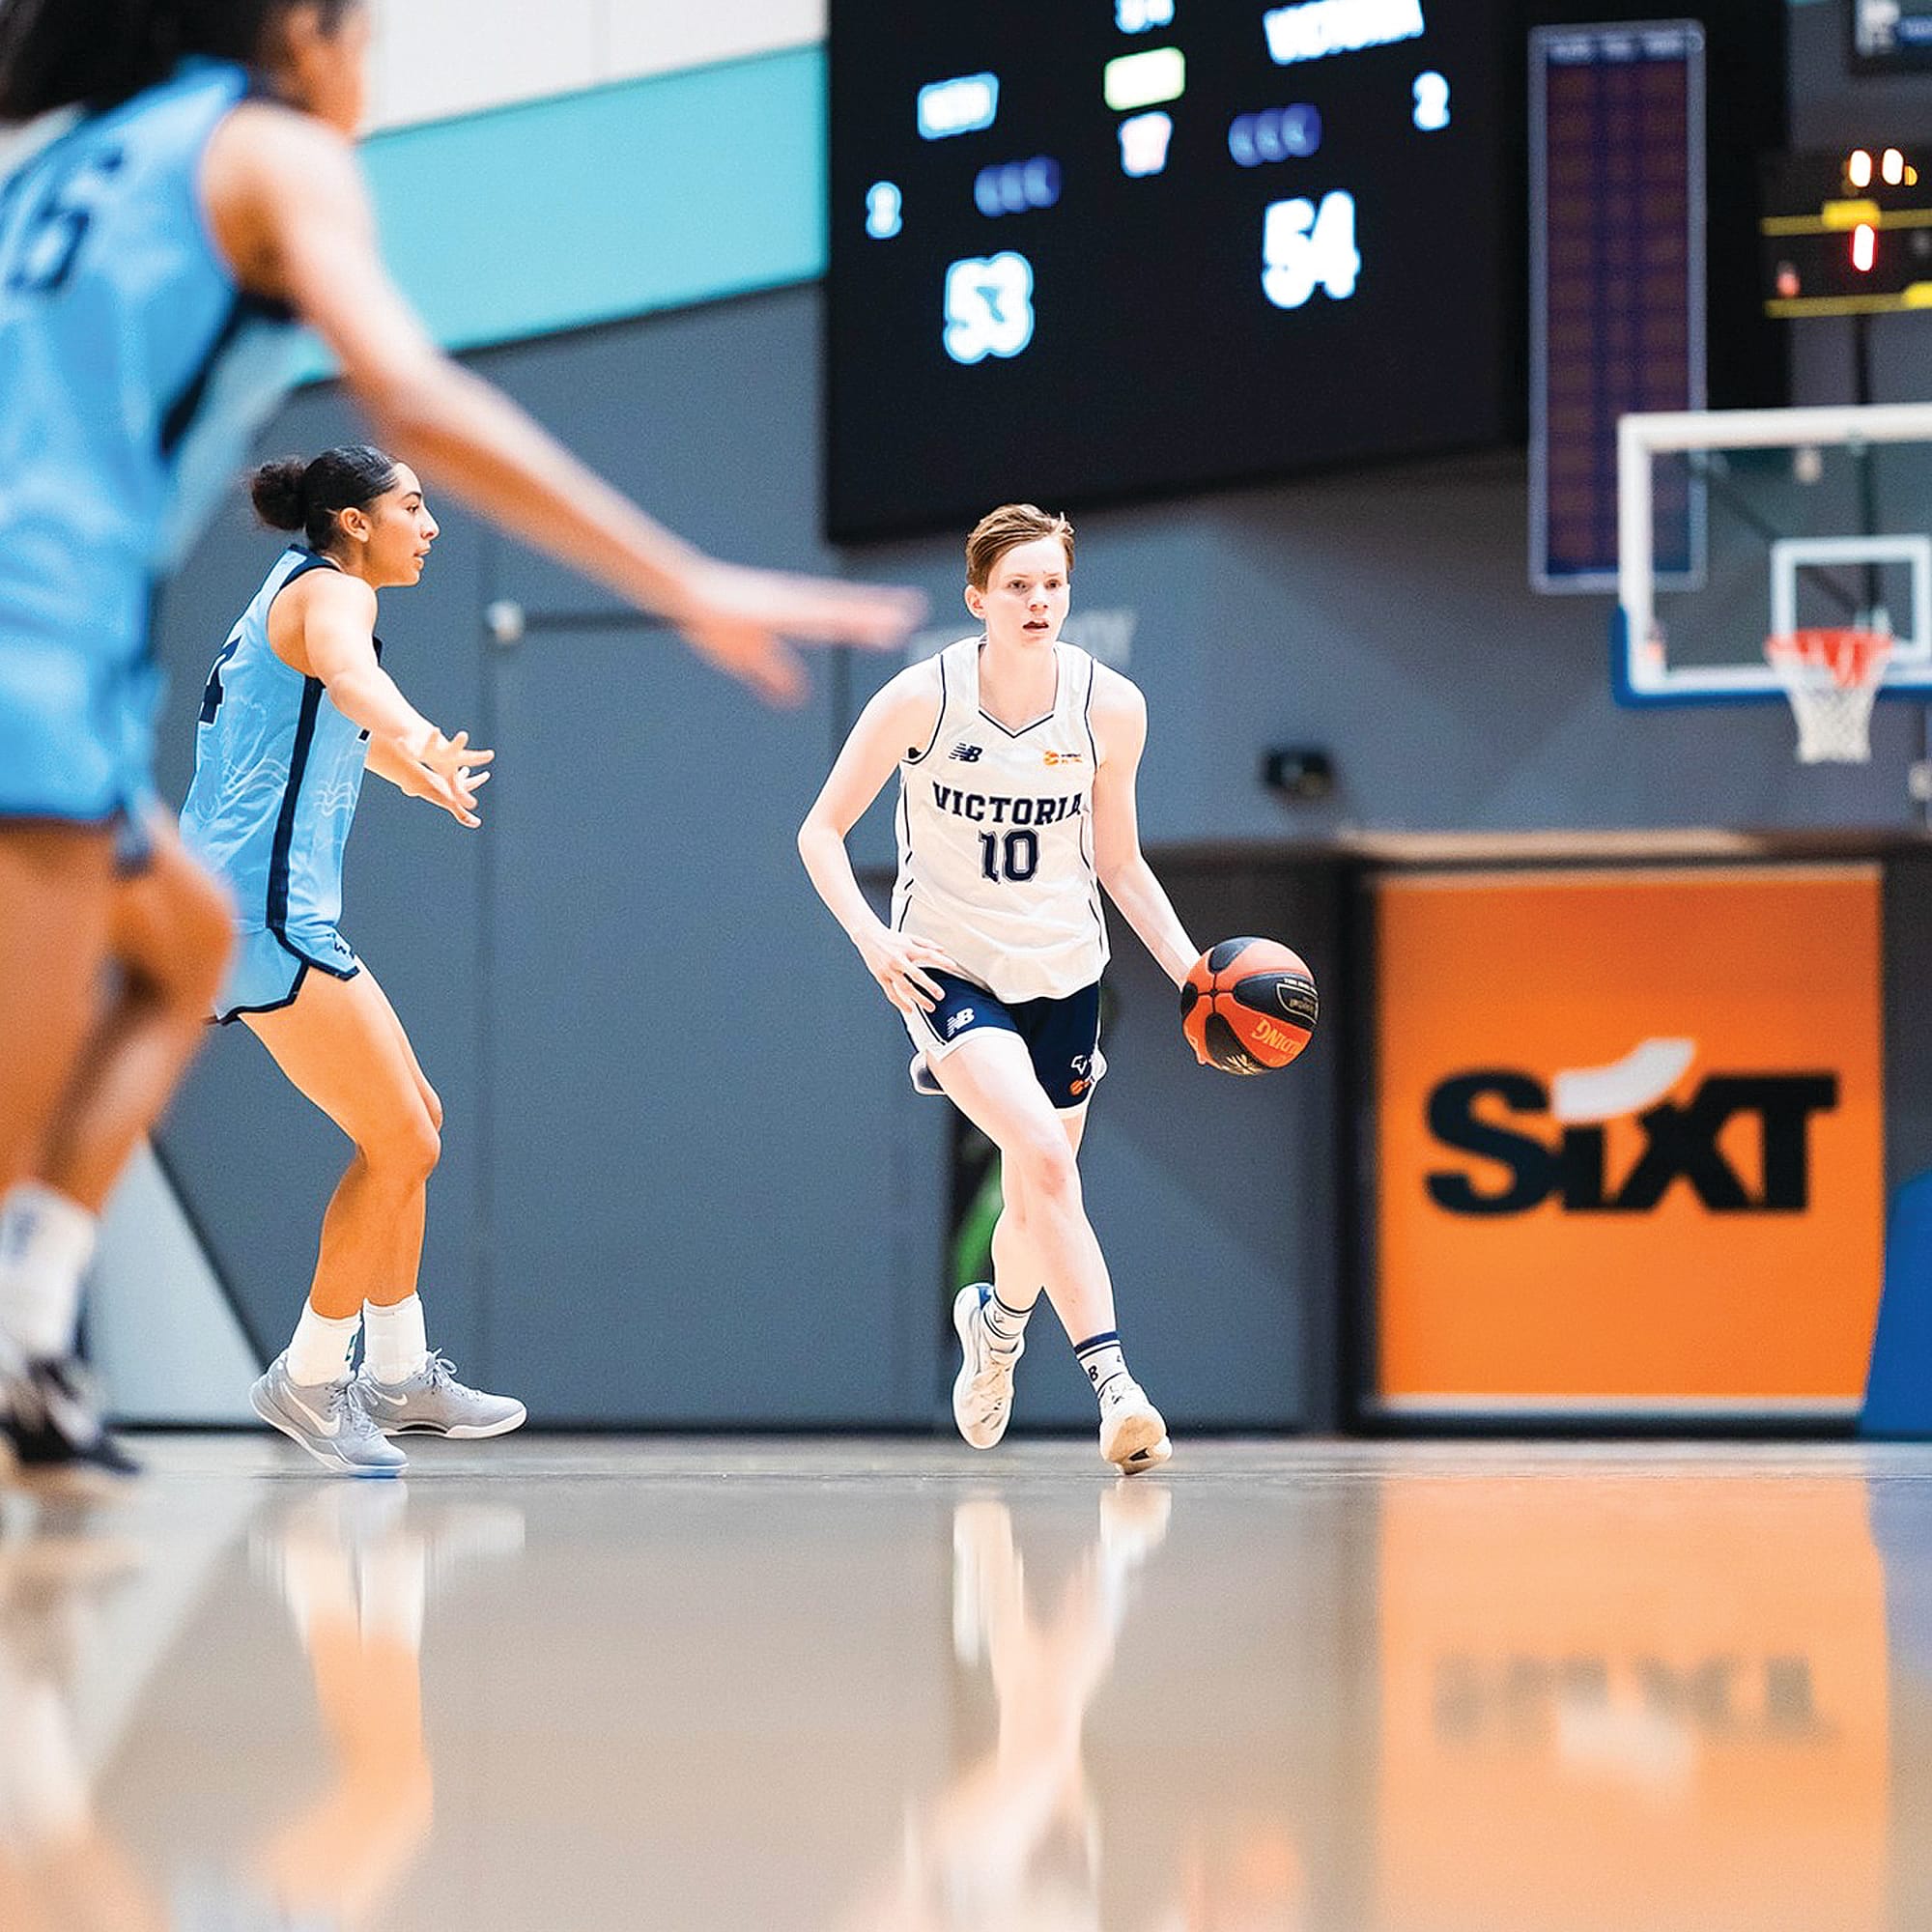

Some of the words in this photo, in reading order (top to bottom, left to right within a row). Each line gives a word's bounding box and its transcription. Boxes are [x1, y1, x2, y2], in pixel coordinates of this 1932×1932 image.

[1263, 191, 1360, 308] 54
[944, 252, 1034, 363] 53
[932, 781, 1083, 826] VICTORIA
[979, 828, 1040, 884] 10
